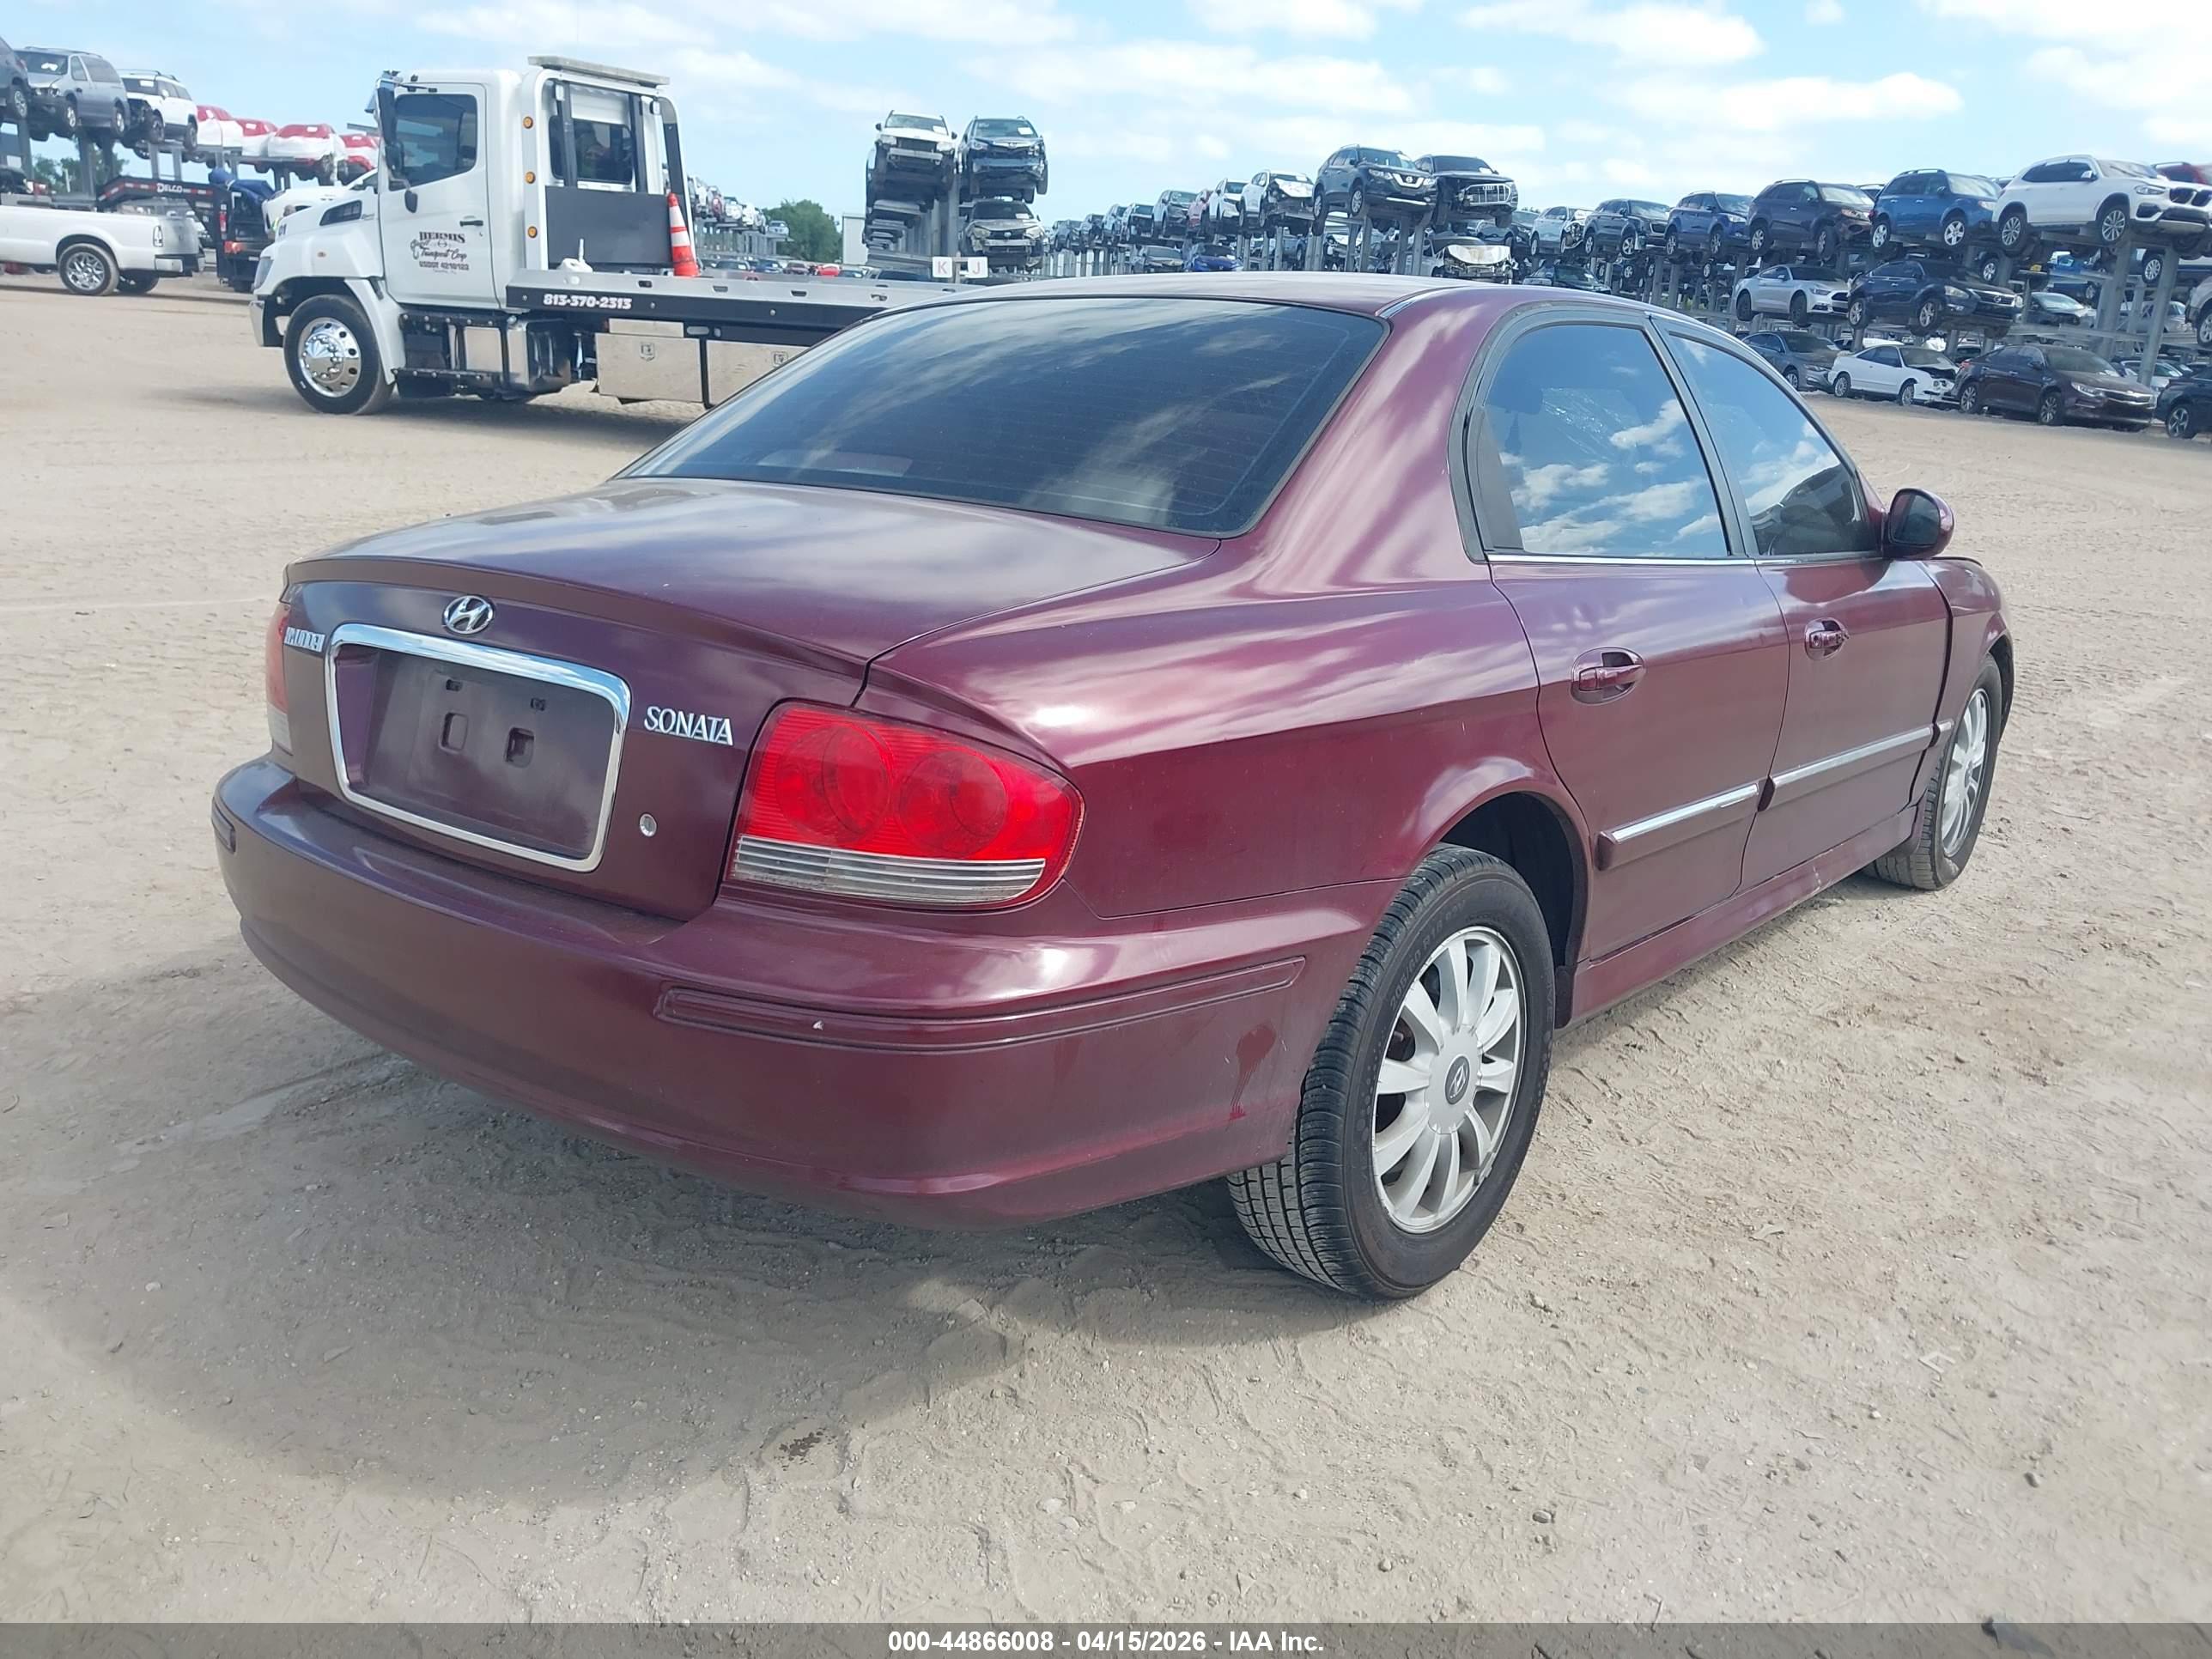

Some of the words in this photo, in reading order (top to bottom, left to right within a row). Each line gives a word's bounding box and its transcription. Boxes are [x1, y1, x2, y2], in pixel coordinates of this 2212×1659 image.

[156, 182, 183, 193] DELCO
[543, 294, 632, 310] 813-370-2313
[643, 705, 733, 746] SONATA
